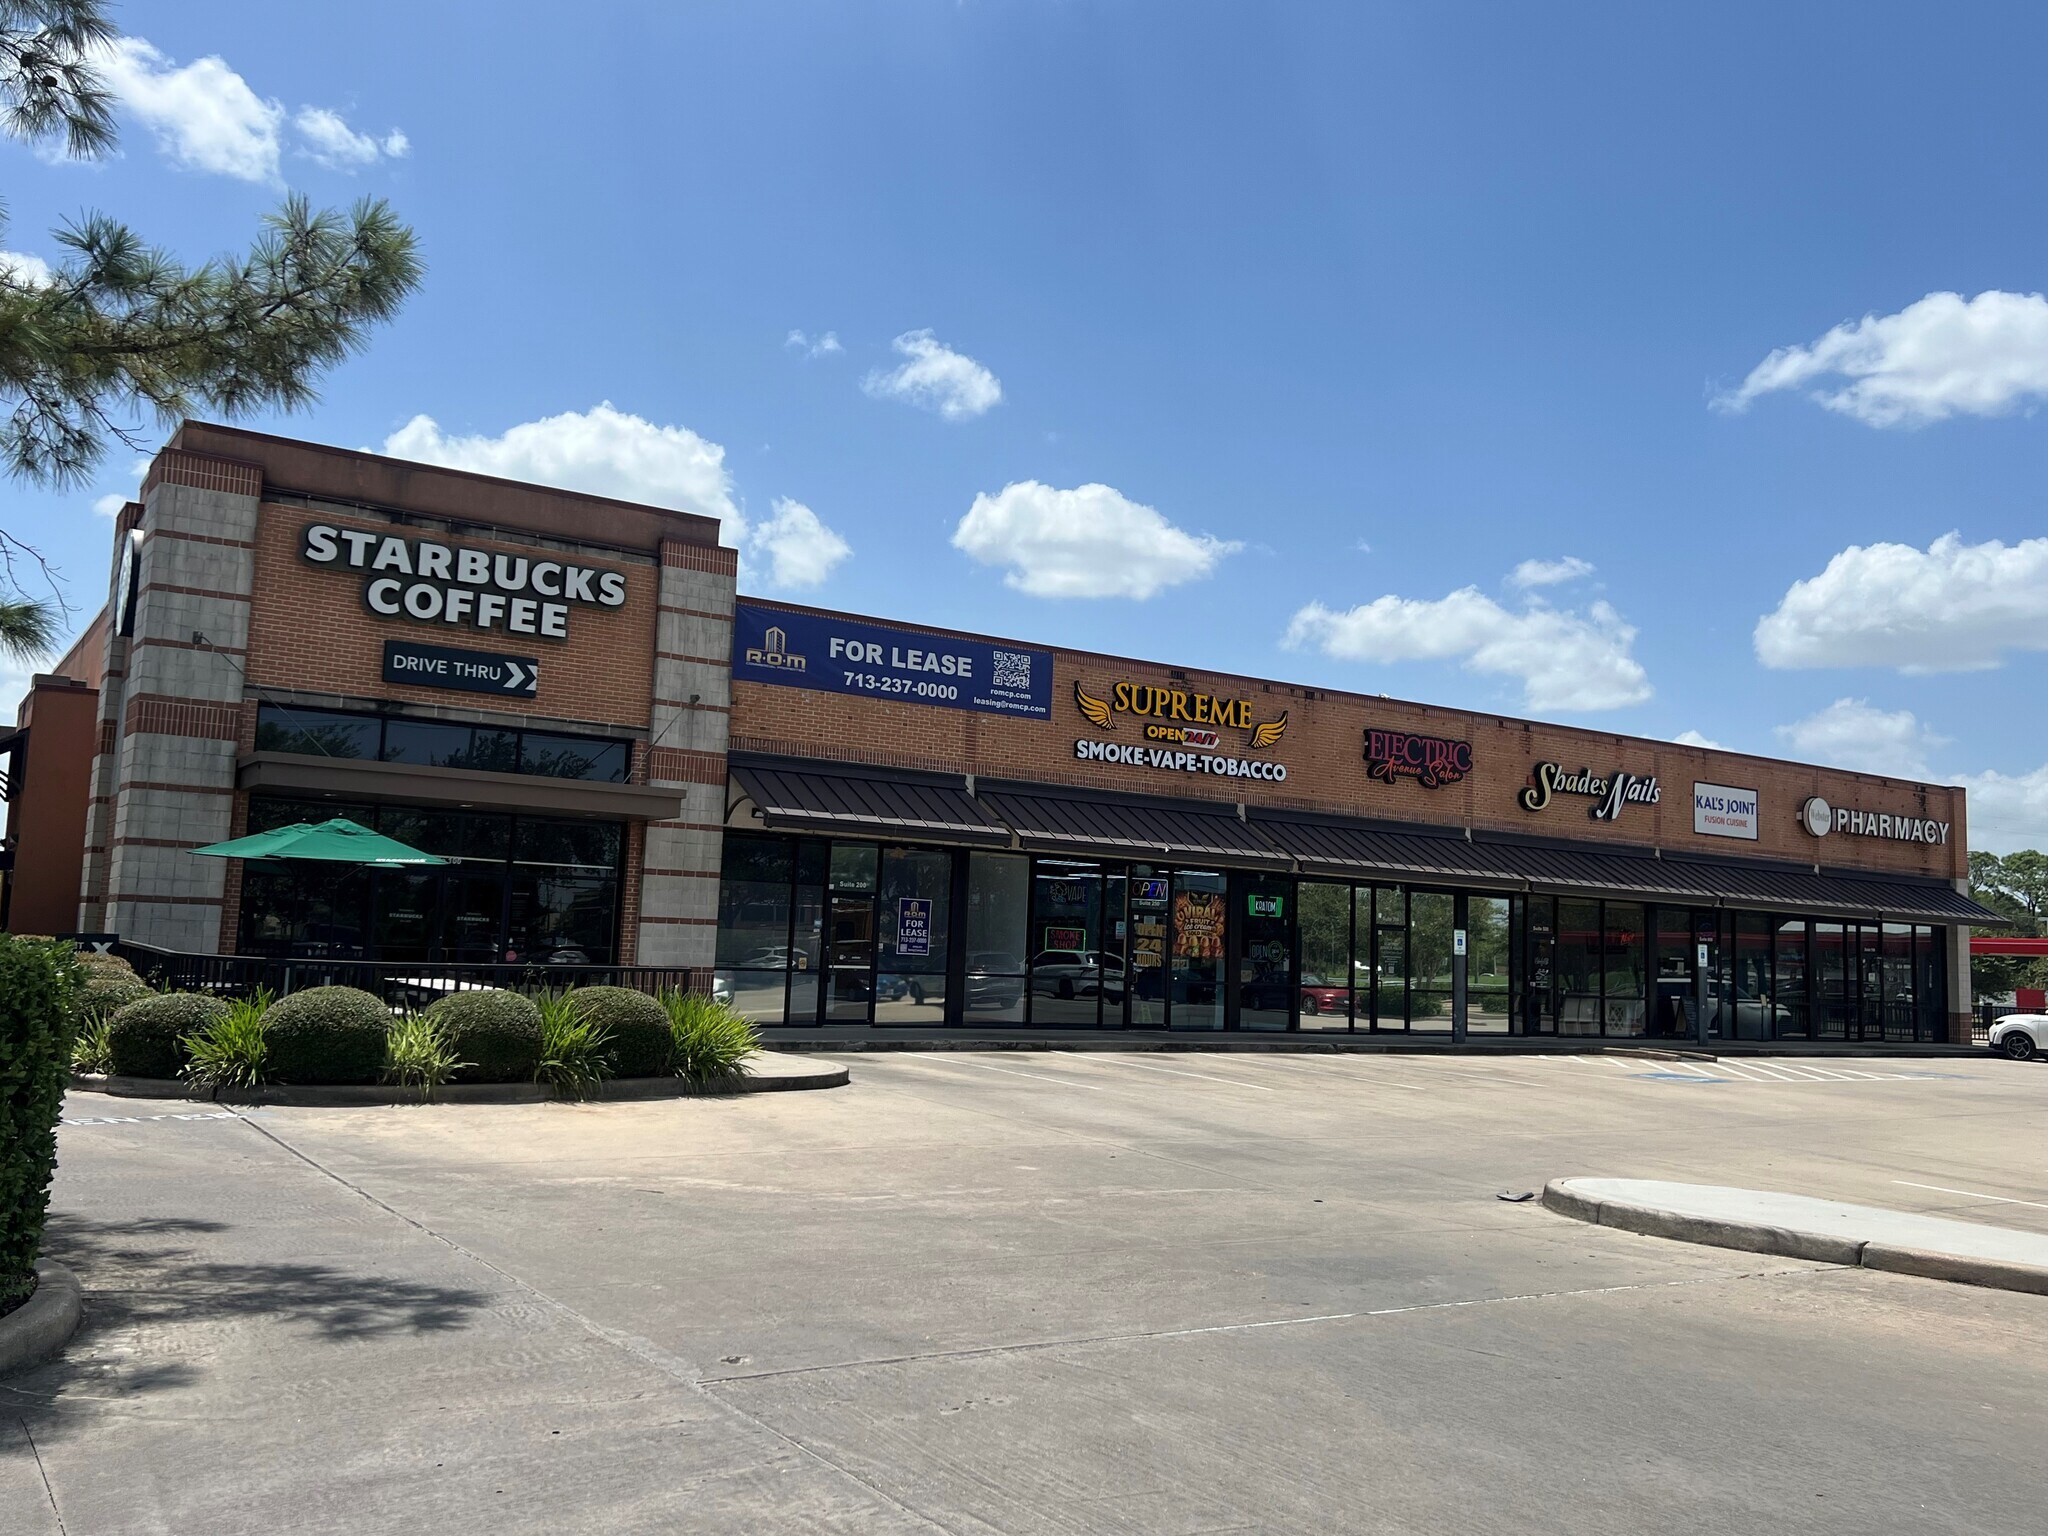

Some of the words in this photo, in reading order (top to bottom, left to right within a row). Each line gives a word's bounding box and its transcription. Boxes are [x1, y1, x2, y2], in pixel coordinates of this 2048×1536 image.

[305, 525, 625, 606] STARBUCKS
[367, 578, 568, 638] COFFEE
[829, 637, 884, 665] FOR
[891, 647, 972, 678] LEASE
[393, 655, 447, 674] DRIVE
[453, 662, 501, 680] THRU
[843, 672, 958, 700] 713-237-0000
[990, 688, 1031, 700] romcp.com
[973, 696, 1046, 713] leasing@romcp.com
[1114, 682, 1253, 729] SUPREME
[1147, 725, 1185, 741] OPEN
[1184, 730, 1218, 746] 24/7
[1368, 731, 1472, 772] ELECTRIC
[1076, 740, 1287, 782] SMOKE-VAPE-TOBACCO
[1373, 756, 1422, 780] Avenue
[1424, 760, 1462, 786] Salon
[1524, 763, 1608, 810] Shades
[1596, 774, 1661, 820] Nails
[1695, 795, 1724, 812] KAL'S
[1726, 799, 1755, 815] JOINT
[1704, 815, 1725, 826] FUSION
[1726, 818, 1748, 828] CUISINE
[1837, 808, 1949, 845] PHARMACY
[840, 880, 854, 888] Suite
[1132, 881, 1167, 897] OPEN
[1067, 885, 1087, 902] VAPE
[1183, 905, 1216, 920] VIRAL
[1255, 900, 1276, 912] KRATOM
[905, 919, 924, 928] FOR
[900, 928, 928, 937] LEASE
[1050, 929, 1080, 941] SMOKE
[1053, 940, 1077, 950] SHOP
[1136, 938, 1162, 952] 24
[1136, 953, 1161, 967] HOURS
